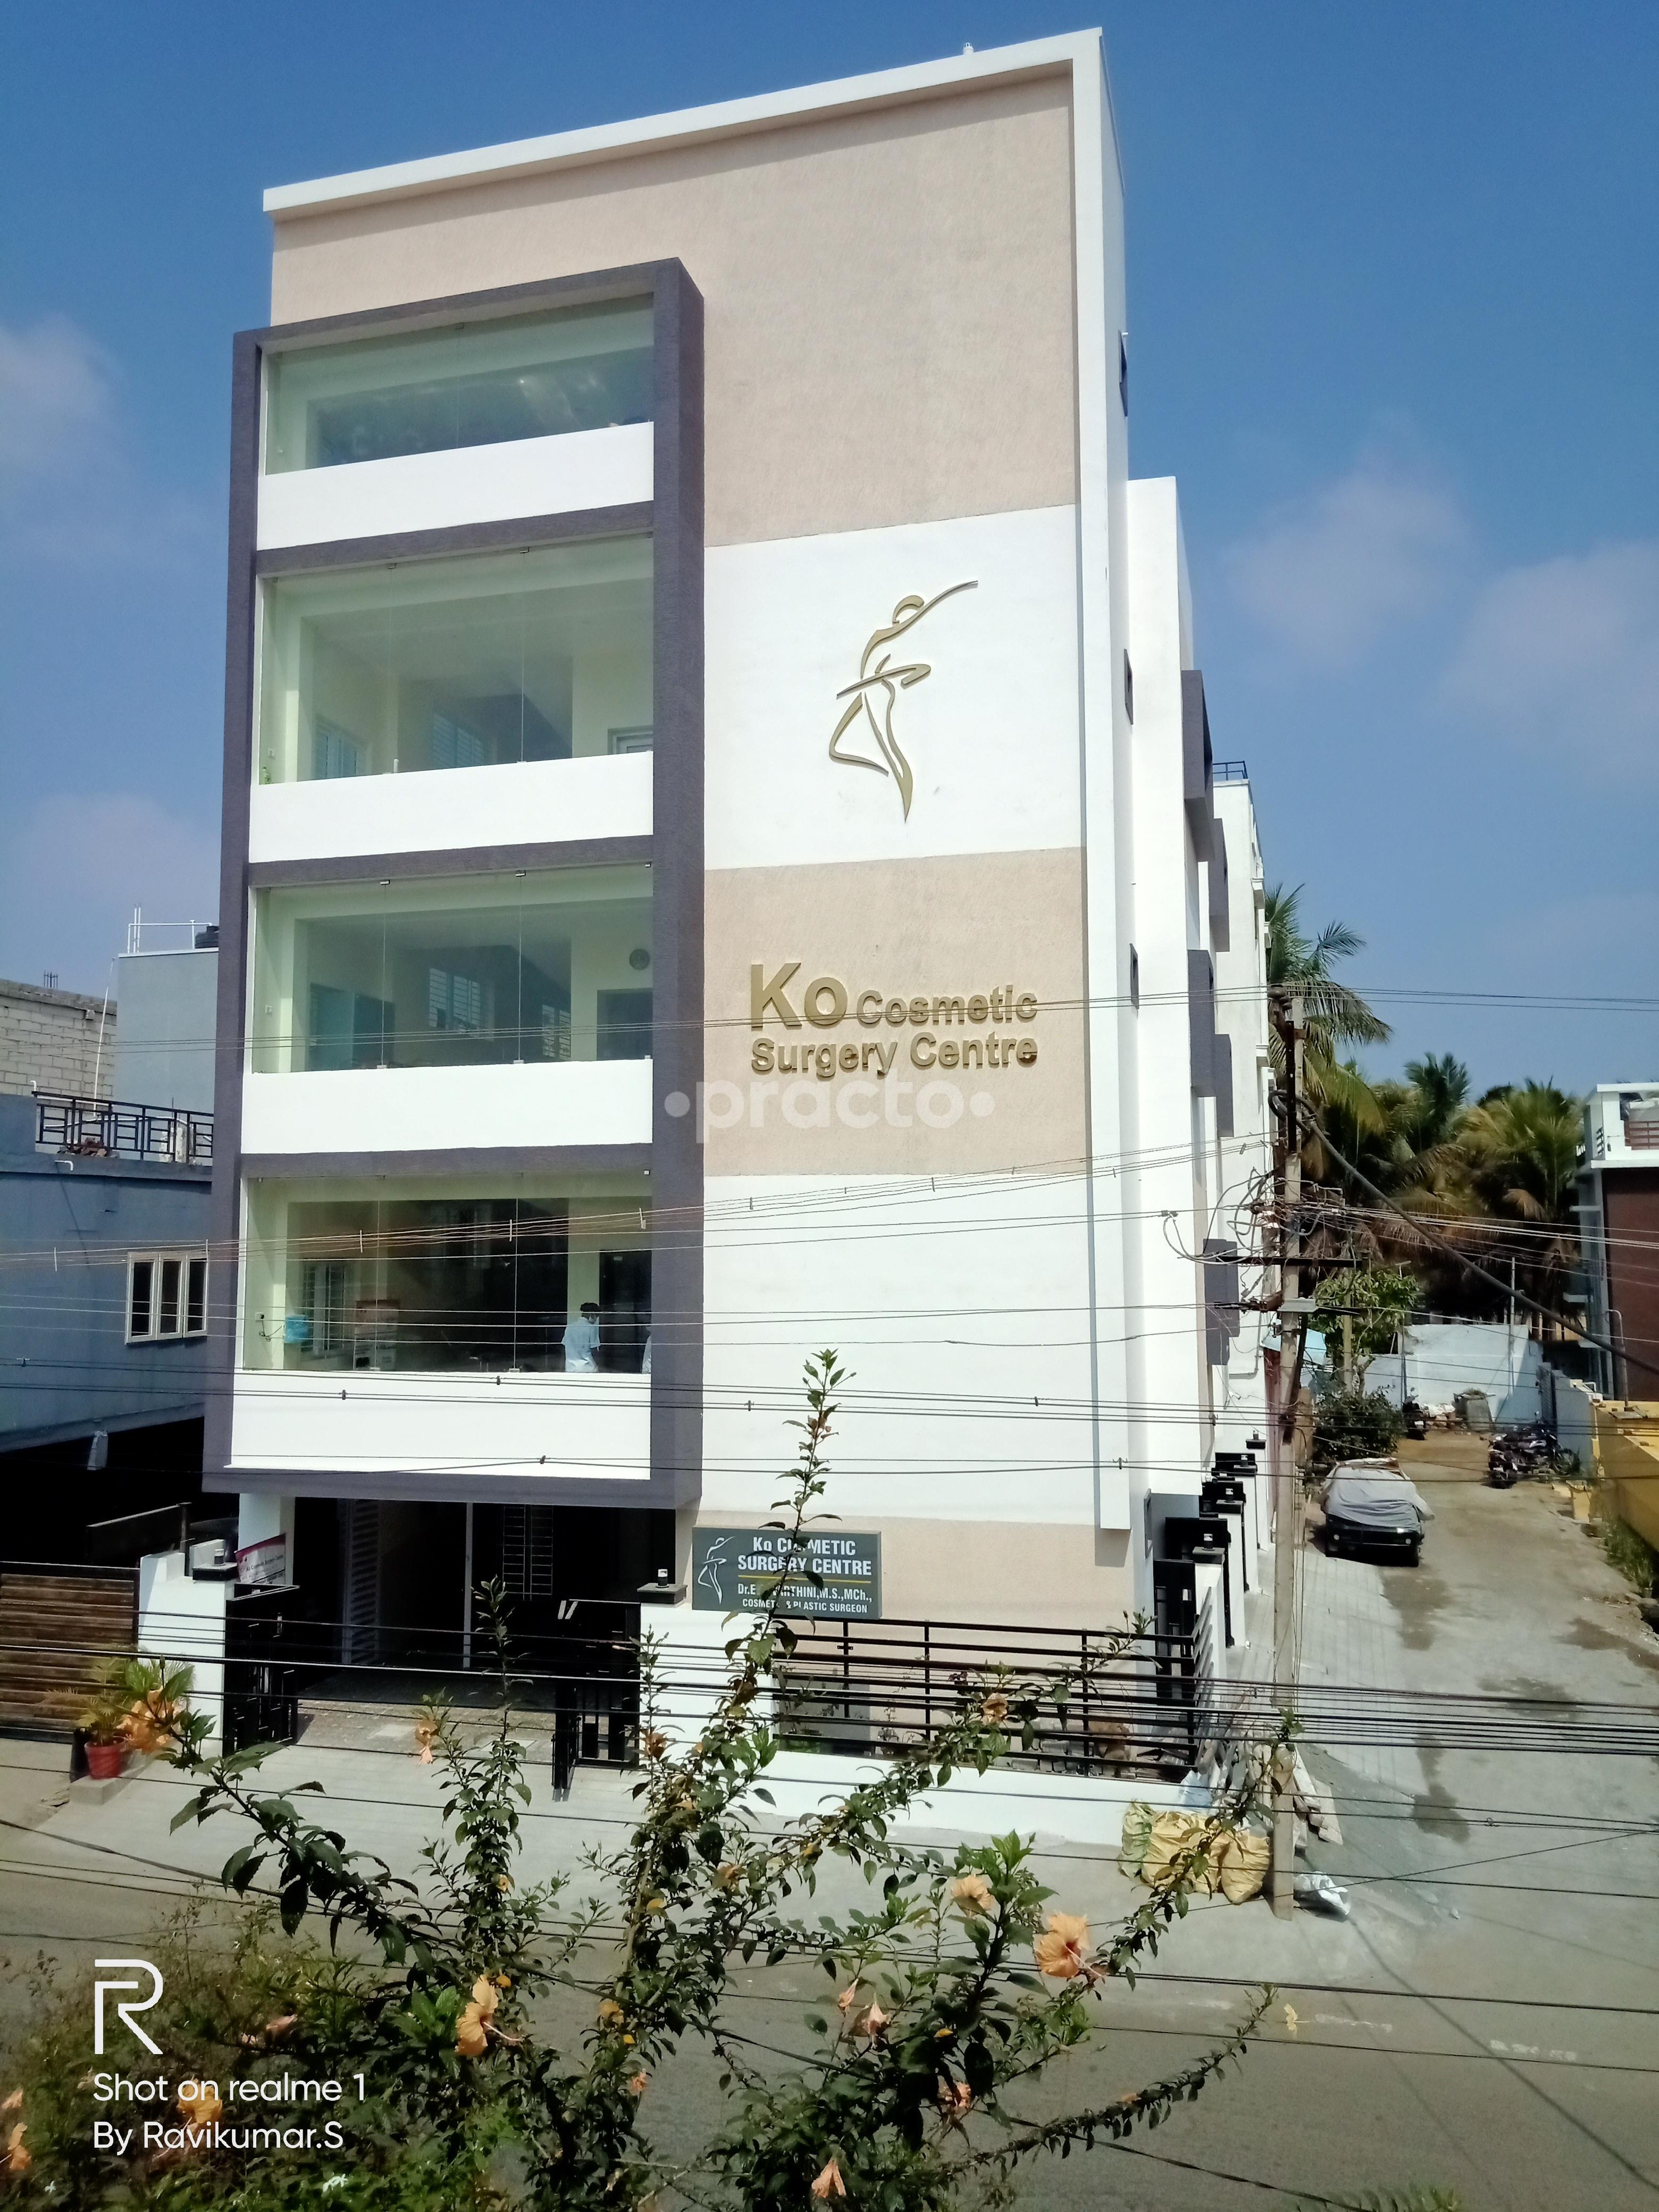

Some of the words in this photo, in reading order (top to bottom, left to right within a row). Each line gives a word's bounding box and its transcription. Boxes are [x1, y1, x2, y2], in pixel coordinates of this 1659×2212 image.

[750, 962, 848, 1027] Ko
[856, 984, 1038, 1024] Cosmetic
[751, 1037, 898, 1078] Surgery
[910, 1032, 1038, 1066] Centre
[753, 1536, 773, 1552] Ko
[777, 1537, 856, 1556] CMETIC
[738, 1554, 807, 1572] SURGERY
[812, 1557, 872, 1576] CENTRE
[742, 1598, 782, 1609] COSMET
[830, 1603, 868, 1613] SURGEON
